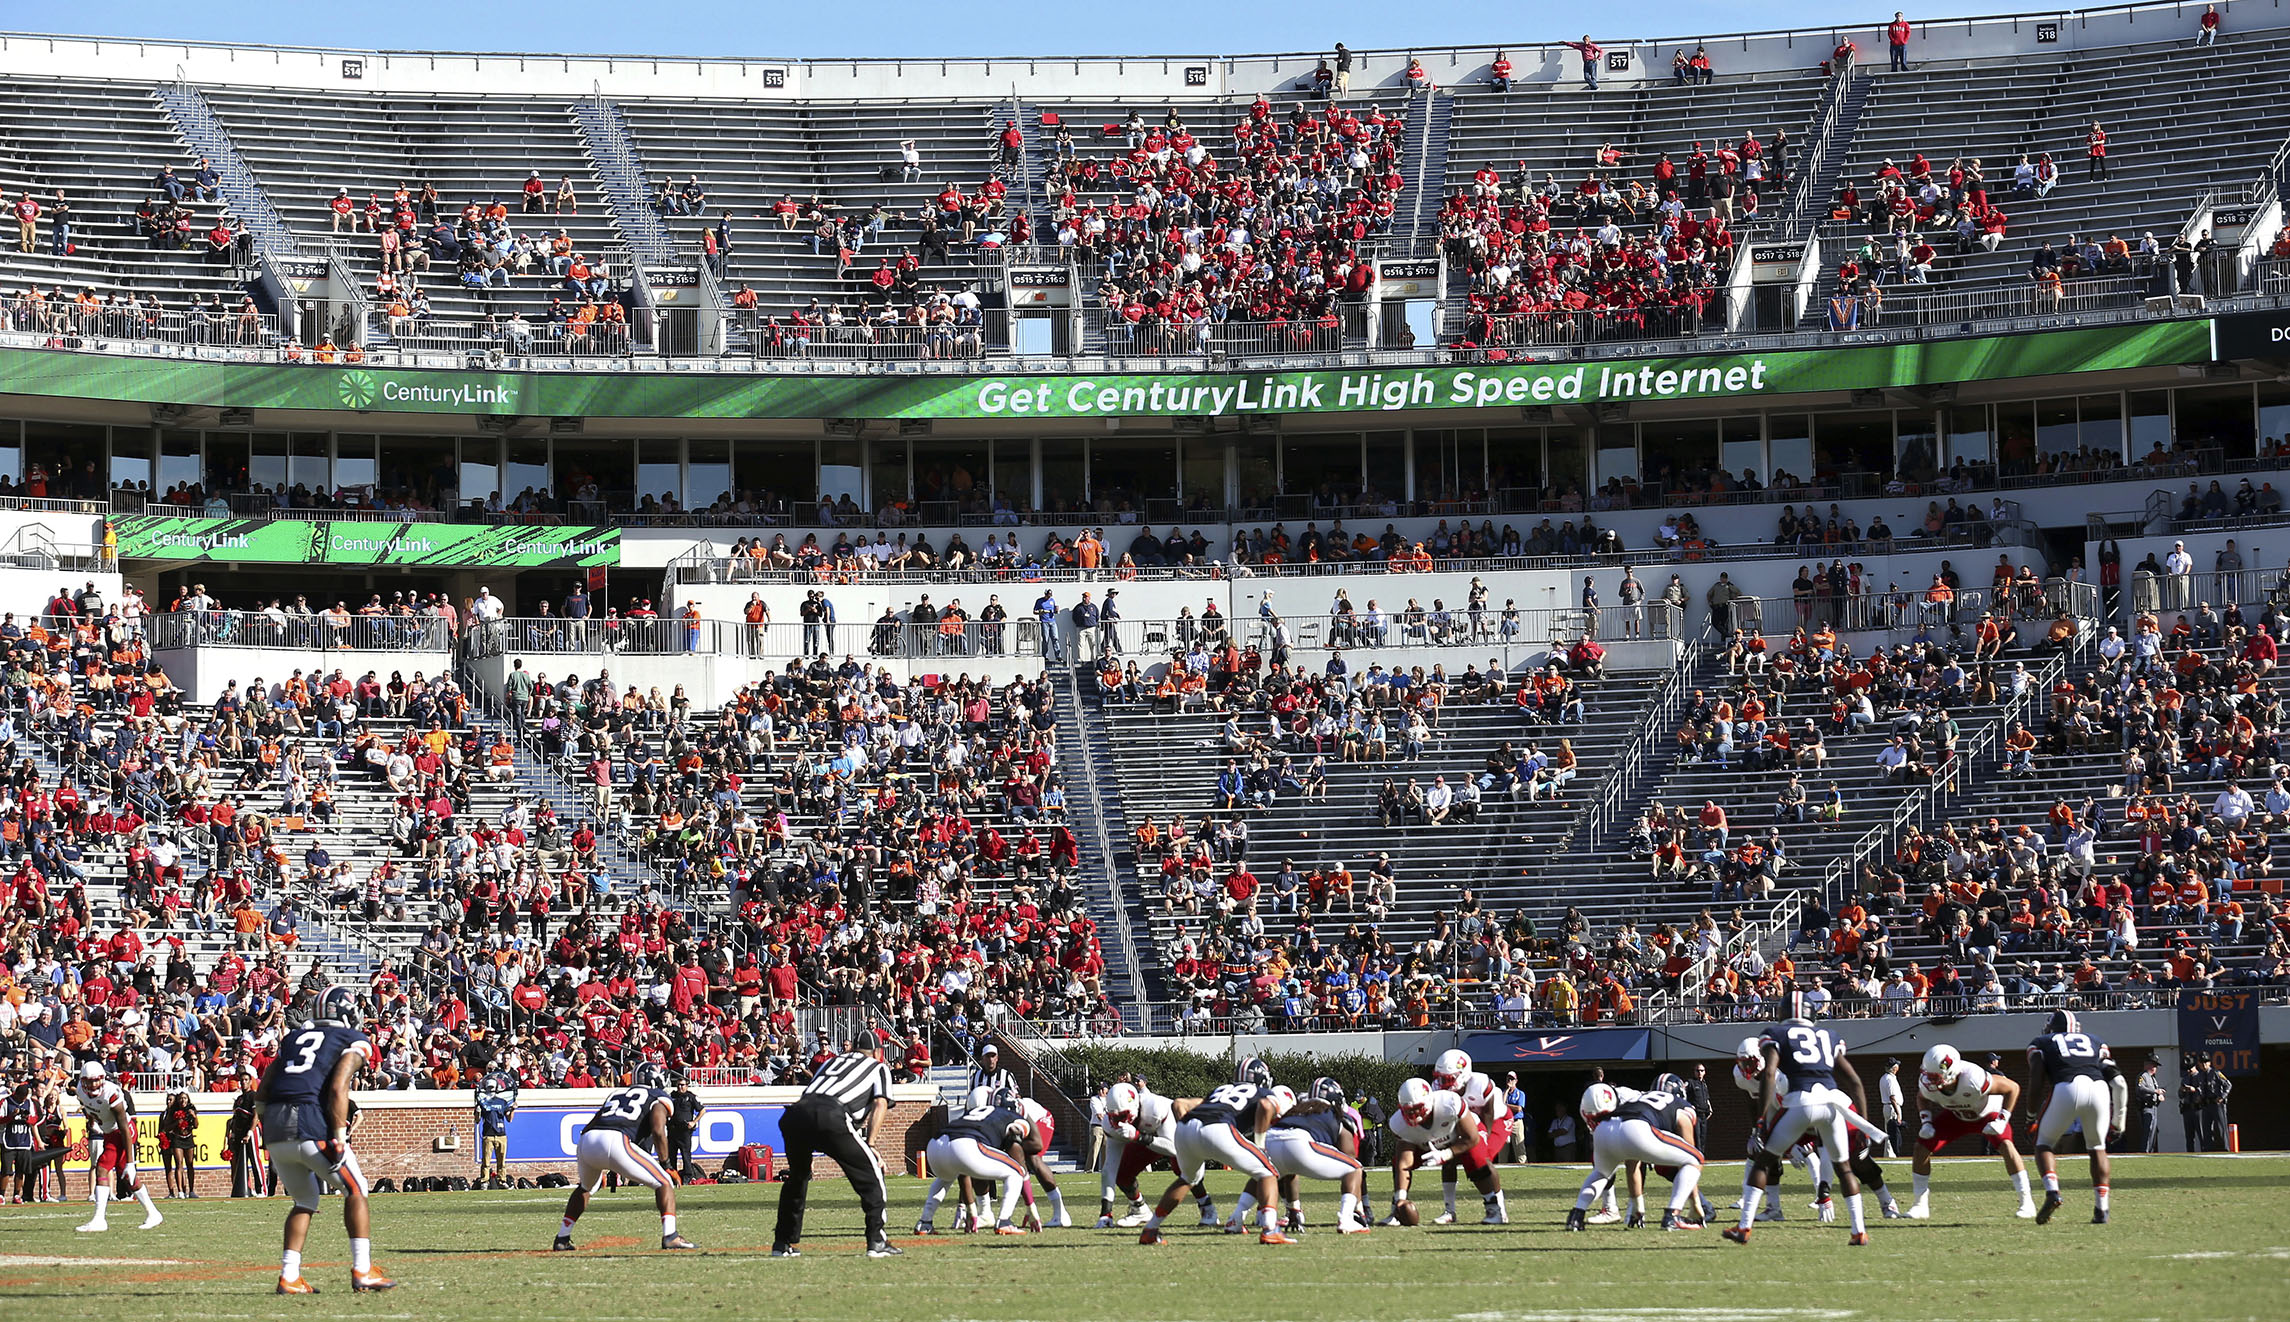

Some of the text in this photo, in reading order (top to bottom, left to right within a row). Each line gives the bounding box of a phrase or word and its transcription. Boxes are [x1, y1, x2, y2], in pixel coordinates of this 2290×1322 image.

[2038, 31, 2056, 40] 518
[344, 67, 361, 76] 514
[1610, 58, 1627, 68] 517
[765, 76, 783, 85] 515
[1187, 74, 1205, 83] 516
[1761, 253, 1776, 262] 517
[1787, 251, 1799, 259] 518
[305, 266, 318, 275] 514
[1390, 267, 1429, 277] 516 517
[651, 276, 665, 285] 514
[676, 276, 690, 285] 515
[1021, 275, 1035, 284] 515
[1045, 275, 1060, 284] 516
[383, 381, 511, 407] CenturyLink
[978, 359, 1766, 416] Get CenturyLink High Speed Internet
[151, 530, 250, 552] CenturyLink
[332, 535, 432, 554] CenturyLink
[505, 538, 607, 557] CenturyLink
[2187, 994, 2250, 1011] JUST
[284, 1031, 325, 1074] 3
[1787, 1026, 1834, 1069] 31
[2051, 1033, 2095, 1058] 13
[2232, 1050, 2259, 1071] IT.
[601, 1088, 649, 1121] 53
